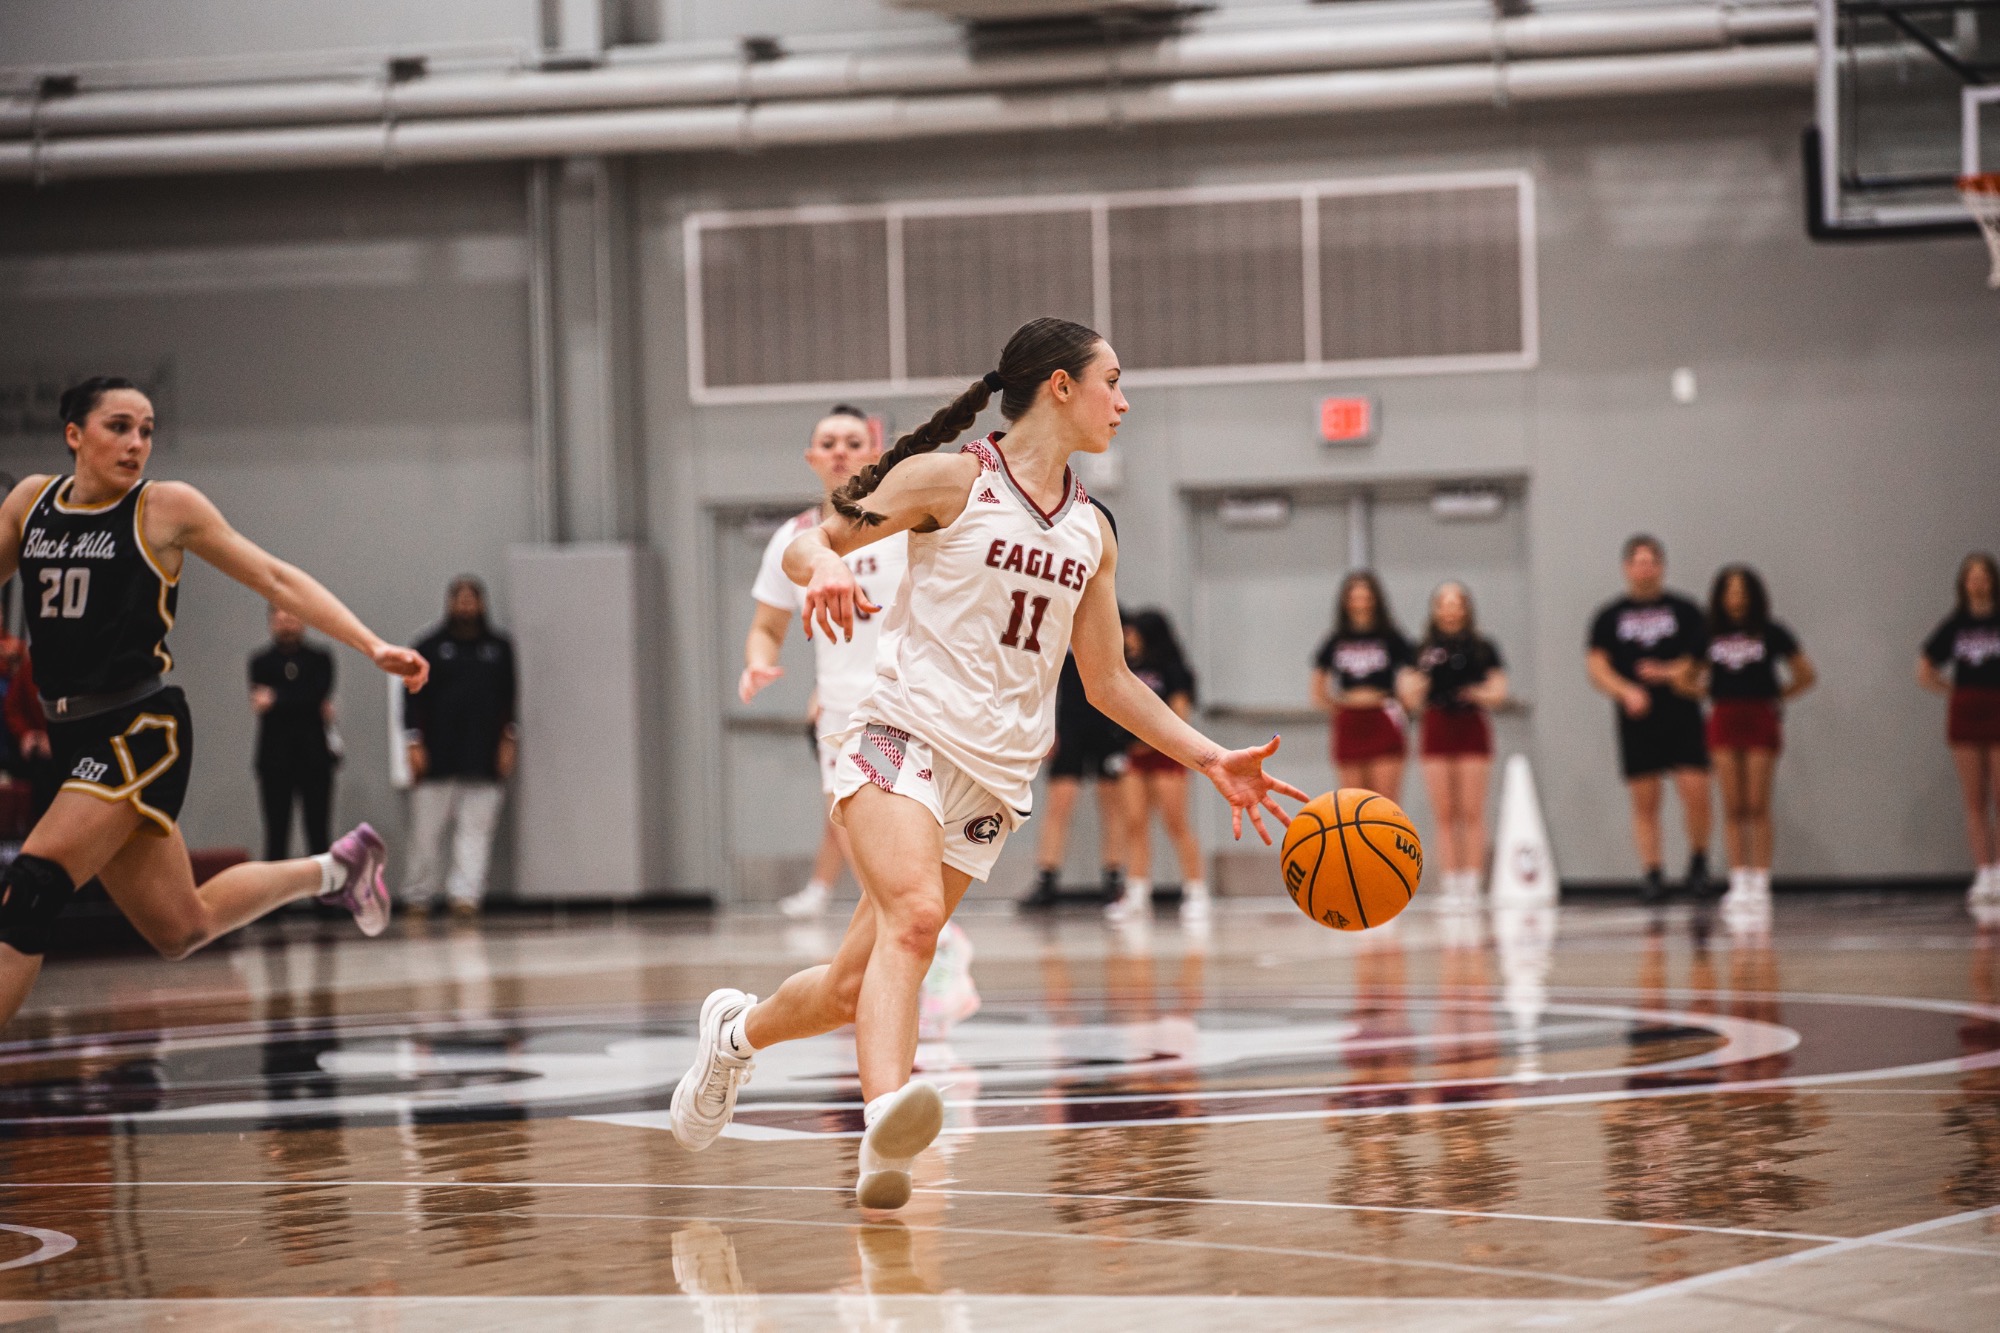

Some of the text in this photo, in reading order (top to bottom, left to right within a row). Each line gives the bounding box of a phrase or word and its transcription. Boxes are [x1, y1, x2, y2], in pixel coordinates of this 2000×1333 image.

[23, 527, 116, 560] Black Hills
[985, 537, 1087, 592] EAGLES
[38, 566, 91, 619] 20
[999, 589, 1052, 654] 11
